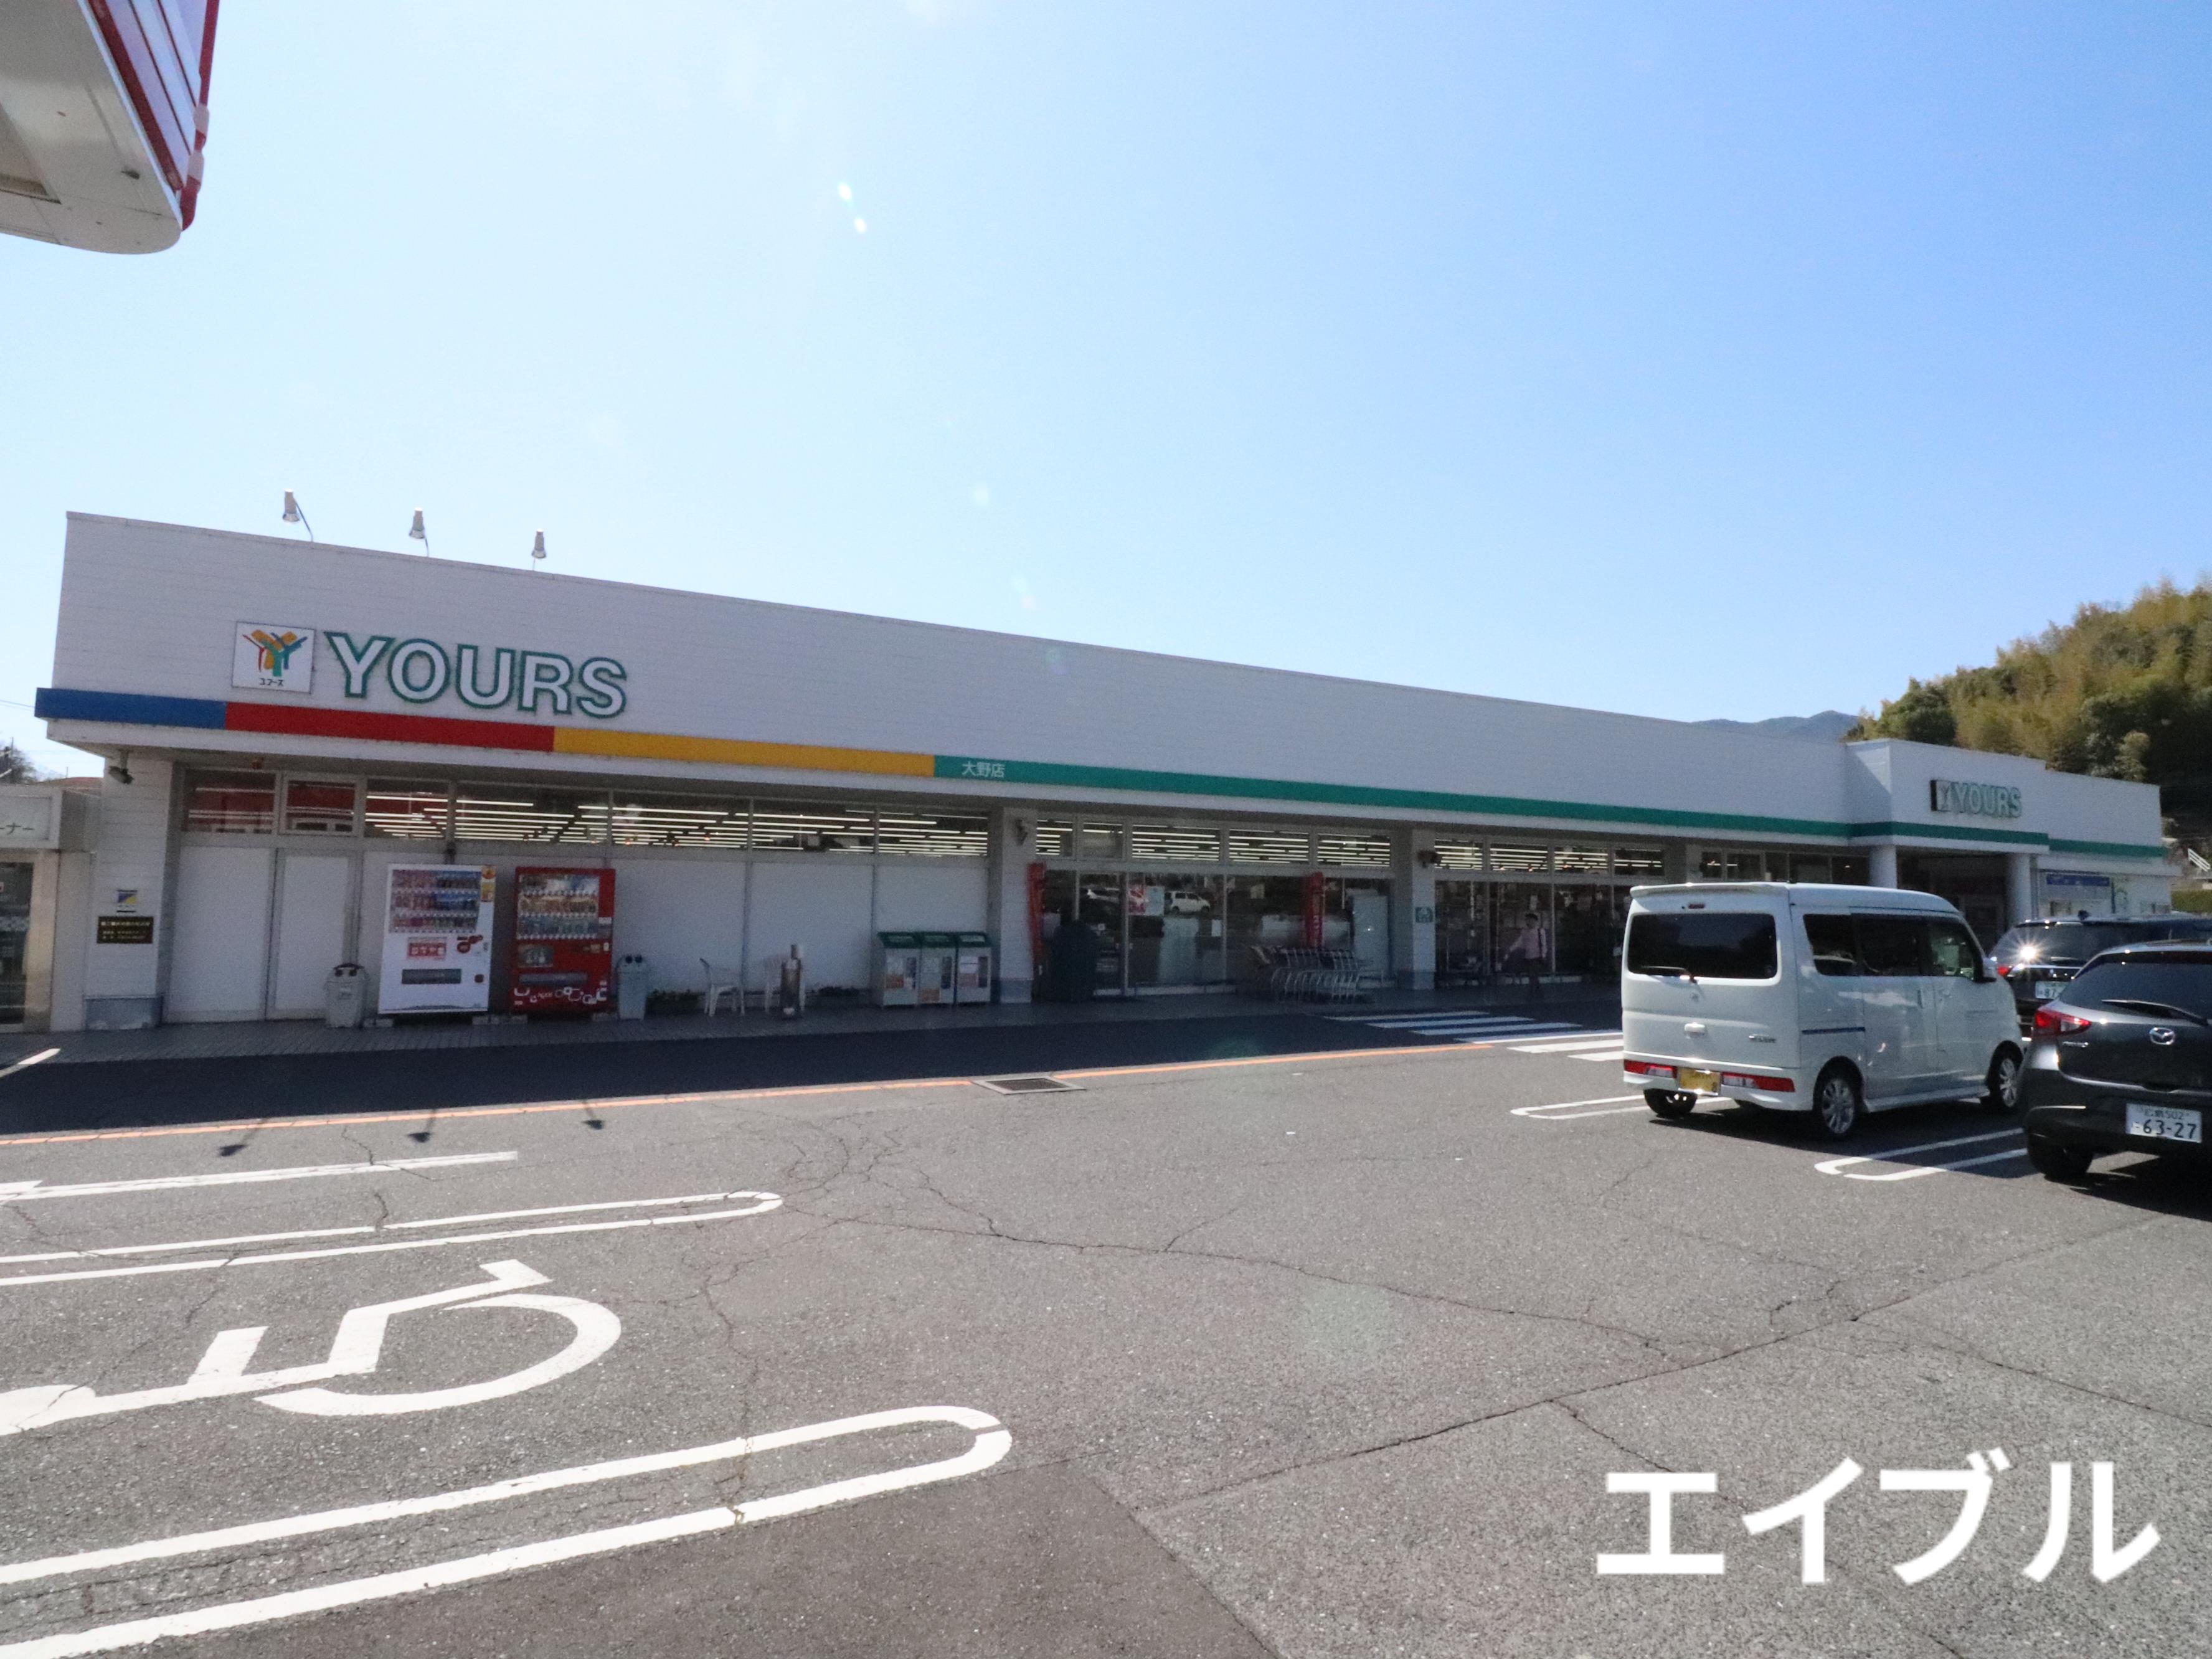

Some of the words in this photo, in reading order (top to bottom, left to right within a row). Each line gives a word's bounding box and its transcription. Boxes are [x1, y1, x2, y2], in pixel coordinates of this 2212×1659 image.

[323, 631, 627, 719] YOURS
[961, 761, 1005, 778] 大野店
[1950, 781, 2022, 818] YOURS
[2143, 1119, 2197, 1140] 63-27
